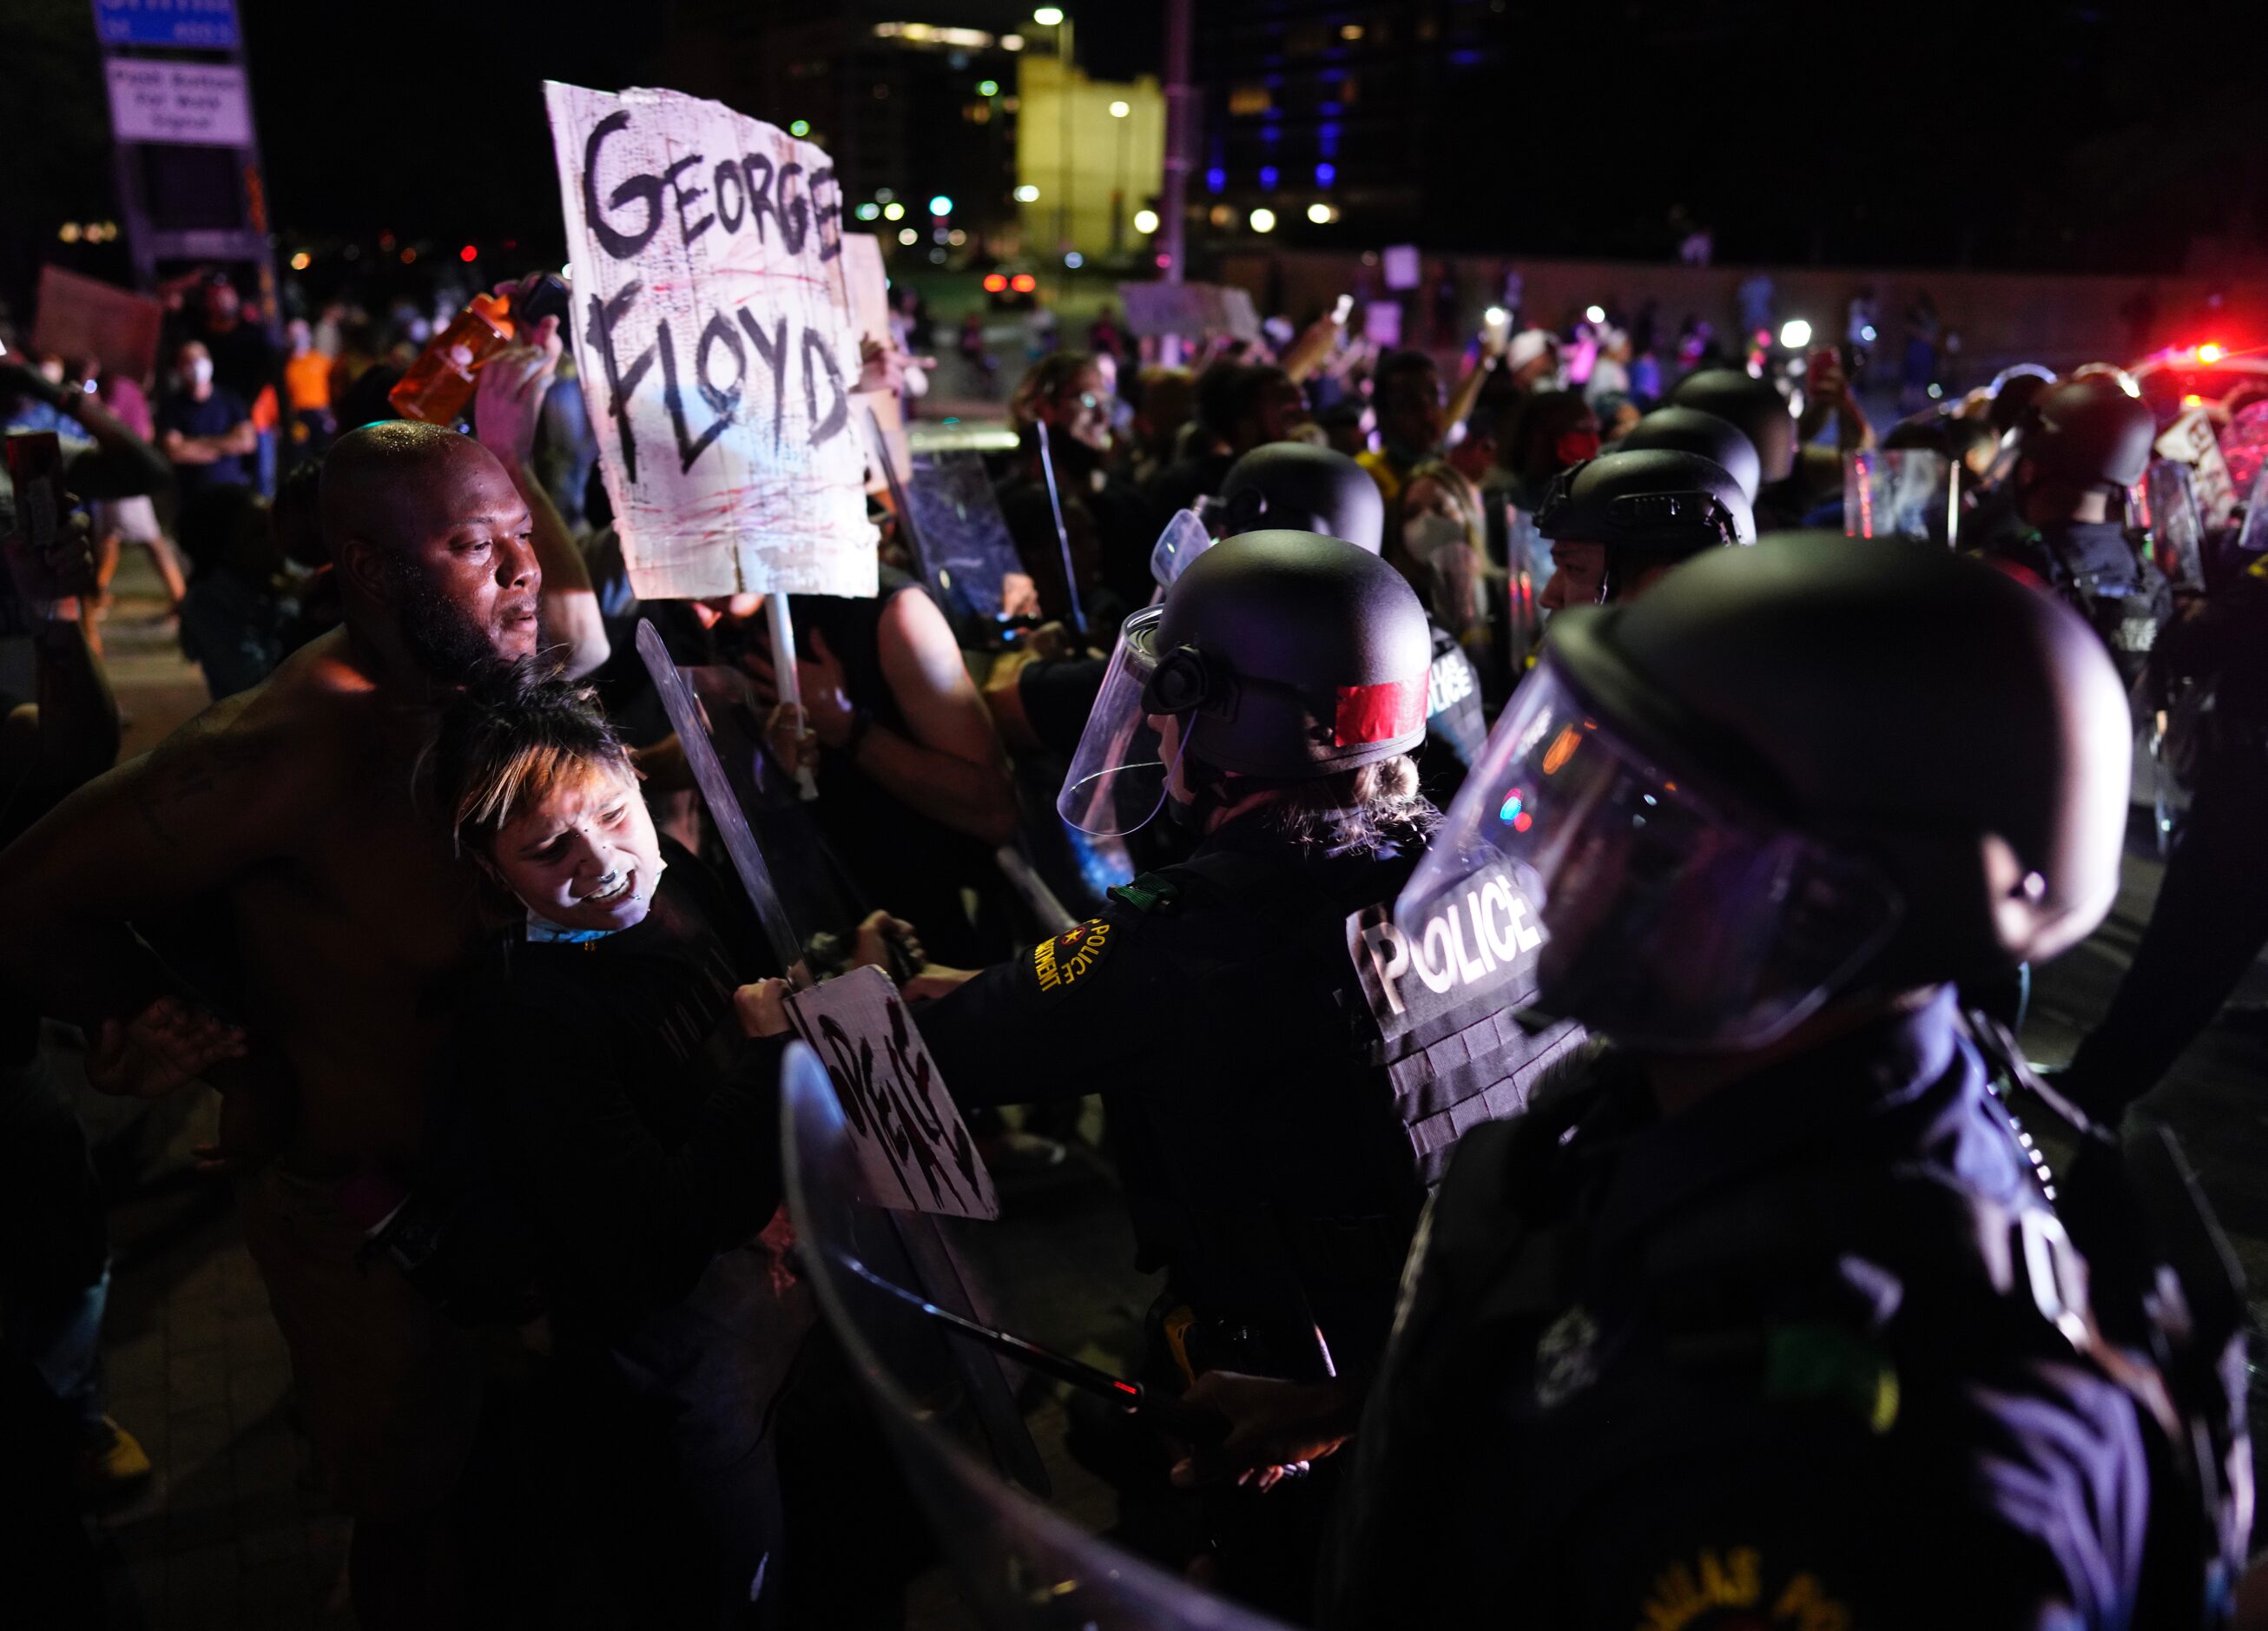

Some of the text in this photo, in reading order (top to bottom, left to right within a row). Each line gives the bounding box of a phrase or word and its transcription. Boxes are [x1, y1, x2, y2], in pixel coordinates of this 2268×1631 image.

[583, 109, 842, 260] GEORGE
[585, 279, 849, 484] FLOYD
[1061, 924, 1111, 985] POLICE
[1362, 875, 1541, 1014] POLICE
